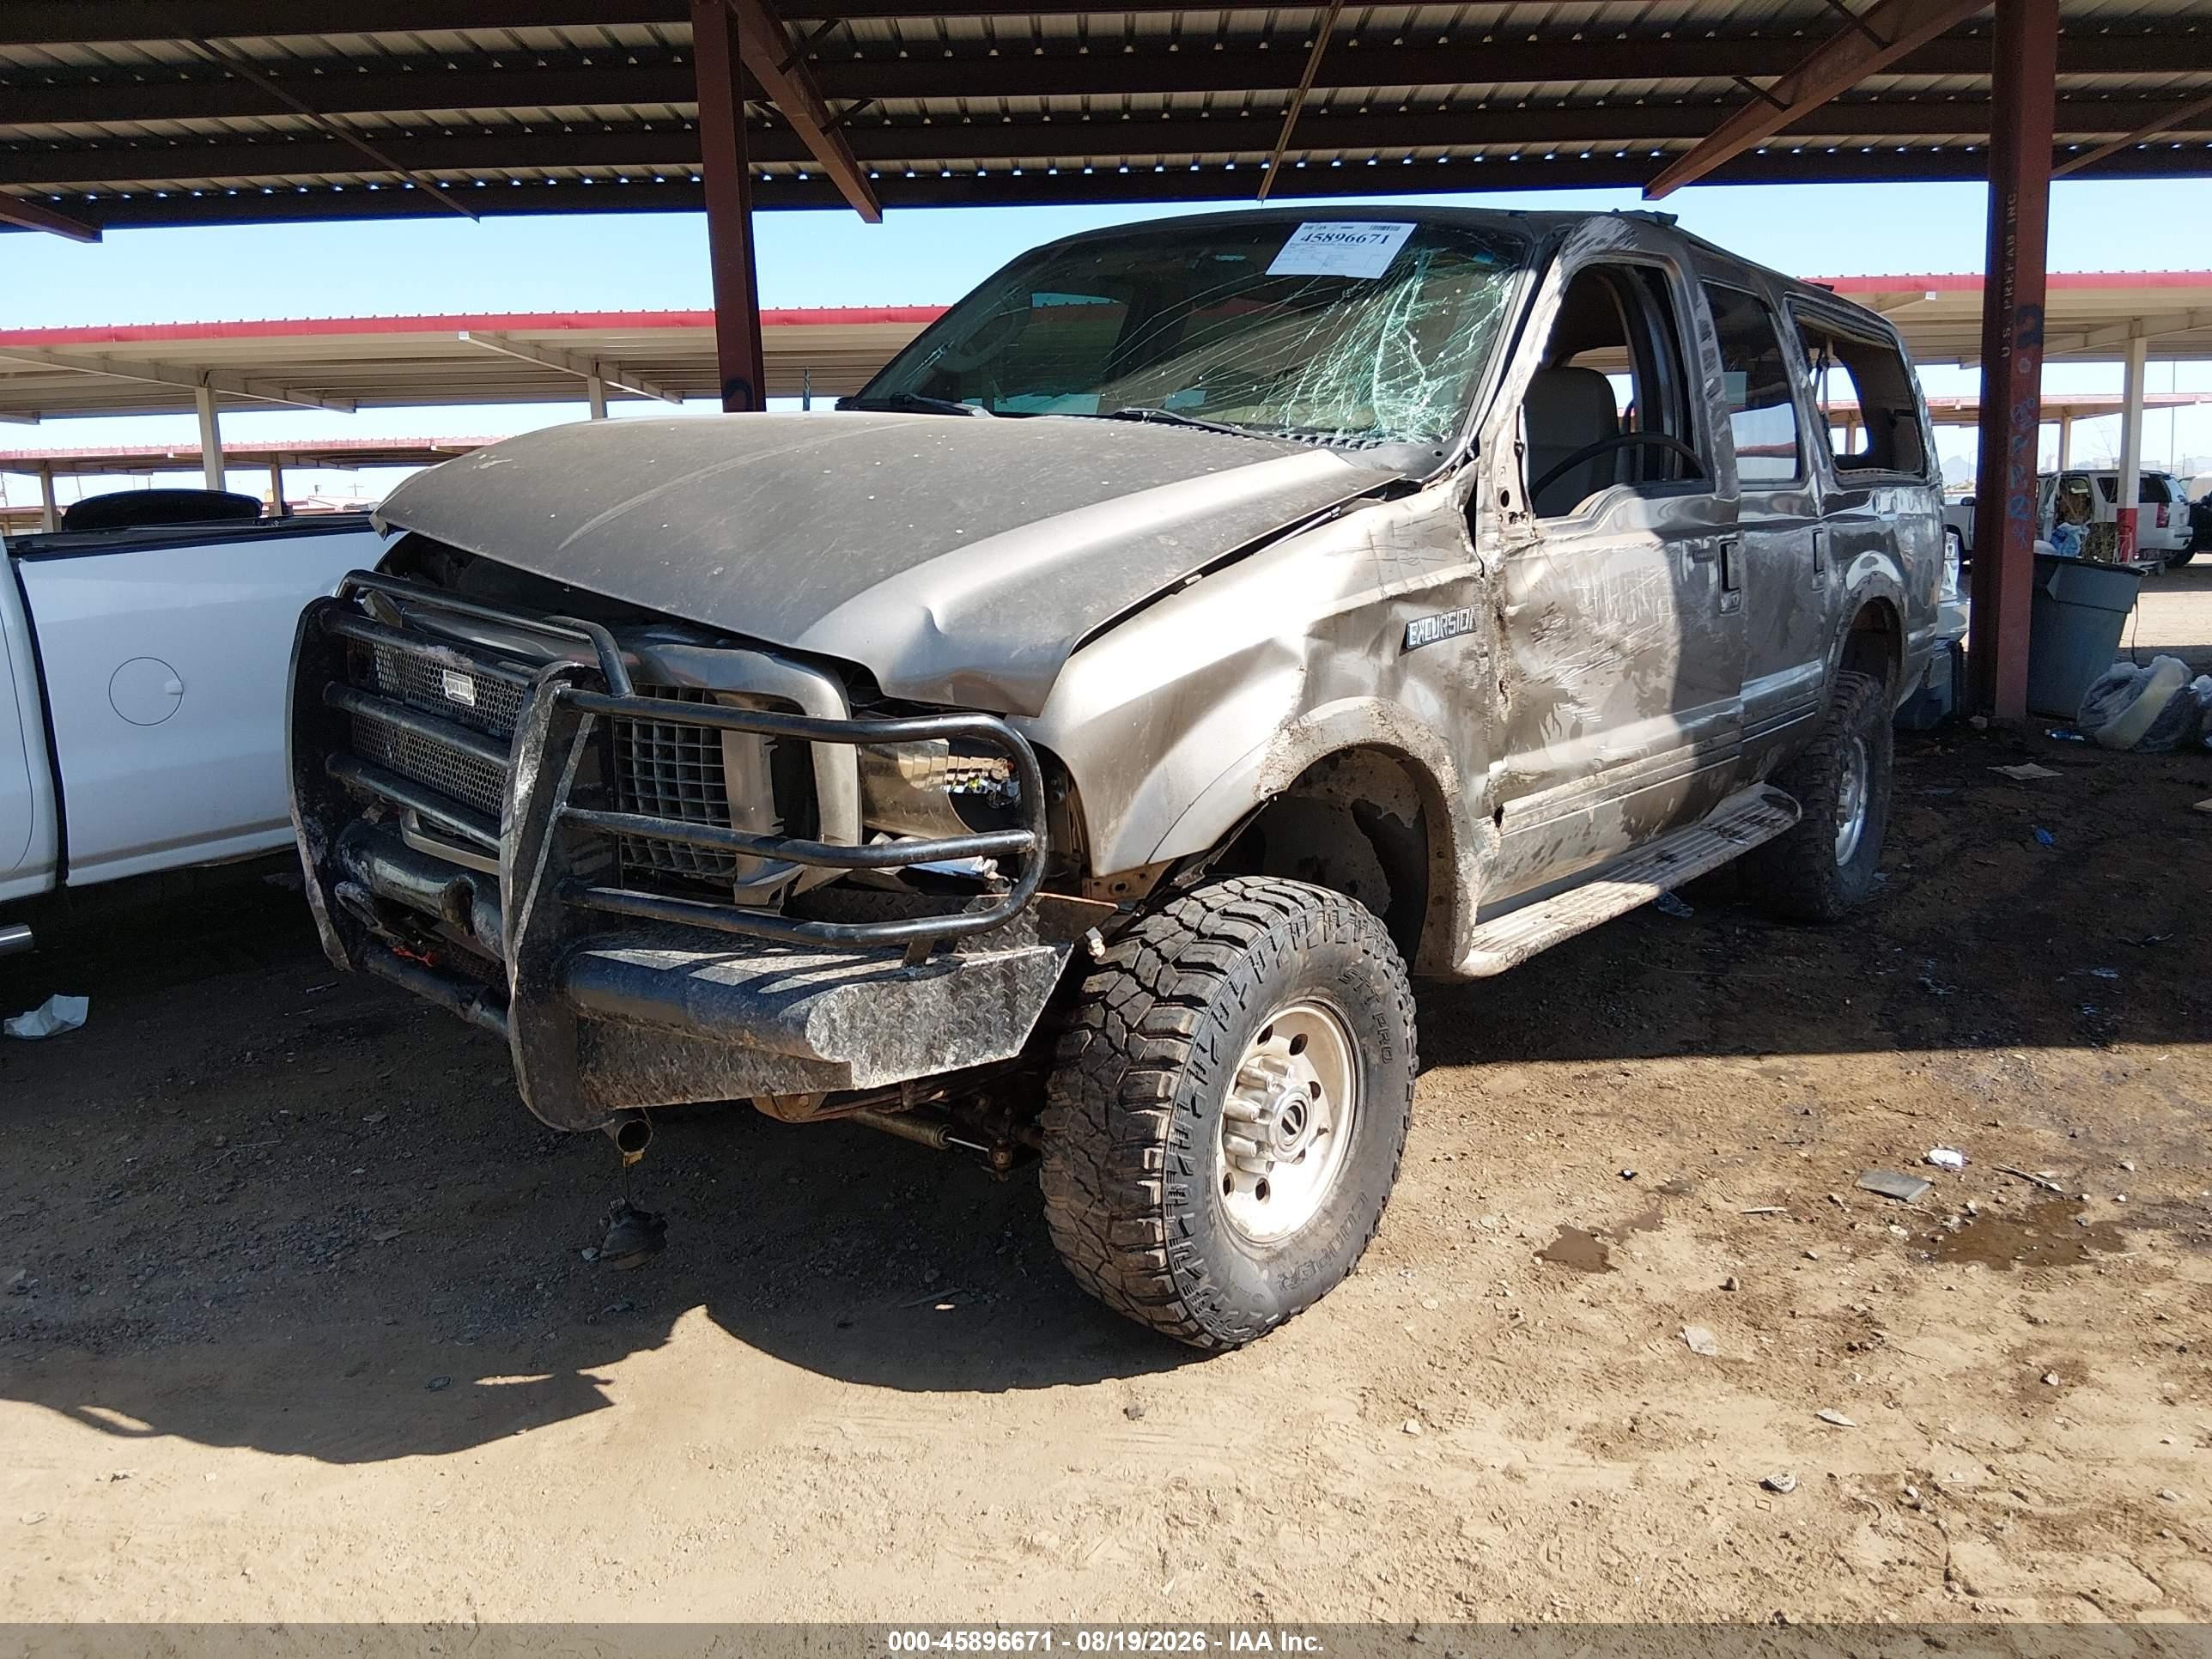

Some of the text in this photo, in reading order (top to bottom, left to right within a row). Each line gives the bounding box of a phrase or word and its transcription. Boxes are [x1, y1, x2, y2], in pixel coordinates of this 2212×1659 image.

[1300, 233, 1389, 245] 45896671
[2001, 185, 2018, 358] U.S. PREFAB INC.
[1408, 606, 1480, 647] EXCURSION
[1336, 967, 1394, 1065] STT PRO
